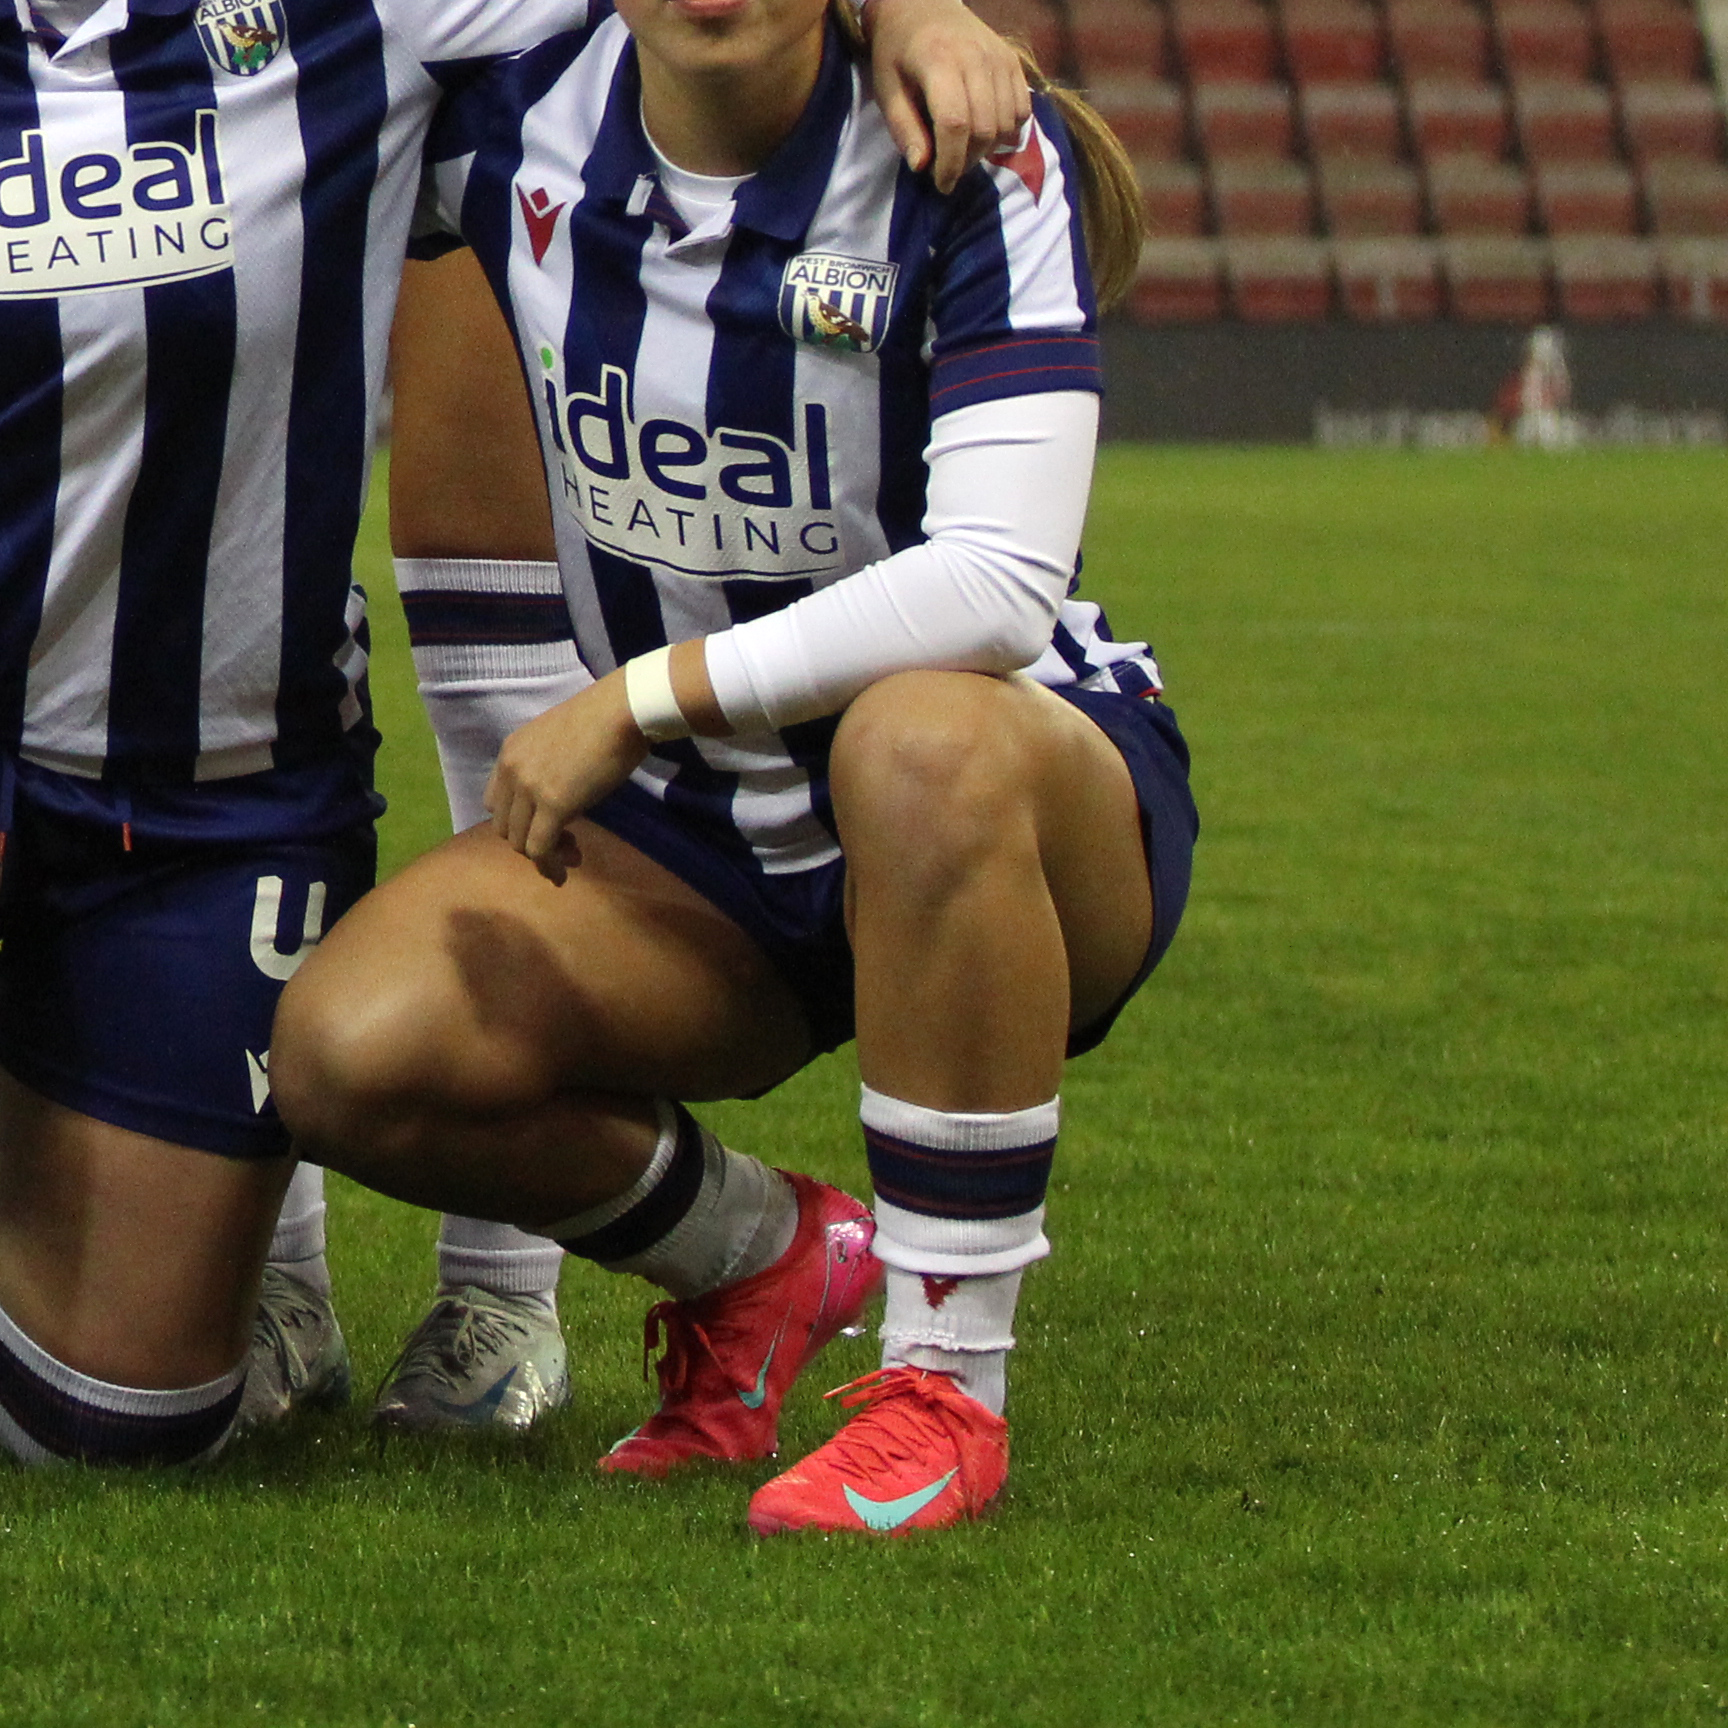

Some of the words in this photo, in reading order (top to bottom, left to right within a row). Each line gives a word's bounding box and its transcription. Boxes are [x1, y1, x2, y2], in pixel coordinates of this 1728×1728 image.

[791, 264, 888, 292] ALBION
[539, 346, 833, 512] ideal
[562, 471, 841, 556] HEATING
